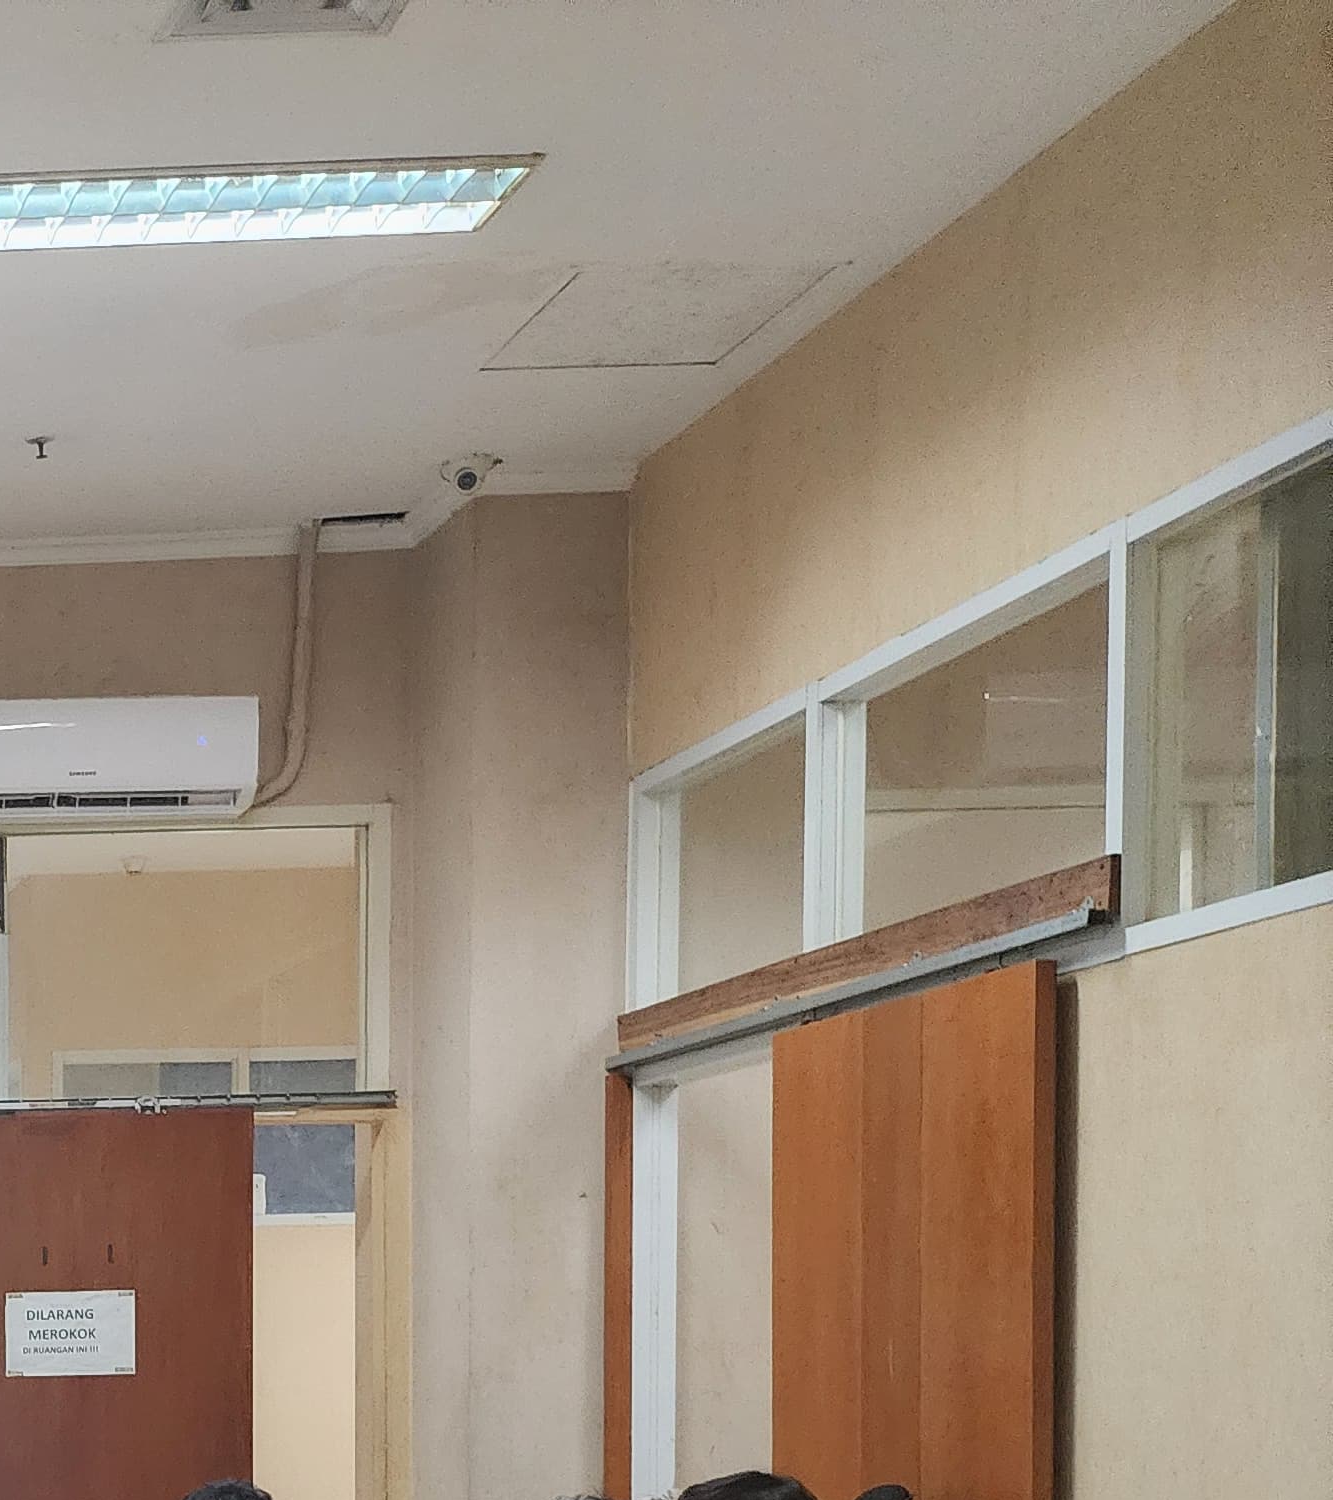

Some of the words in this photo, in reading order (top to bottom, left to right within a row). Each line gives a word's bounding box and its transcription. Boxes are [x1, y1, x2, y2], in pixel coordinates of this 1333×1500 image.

[26, 1308, 94, 1321] DILARANG
[28, 1327, 97, 1341] MEROKOK
[22, 1346, 31, 1354] DI
[33, 1345, 74, 1354] RUANGAN
[76, 1345, 88, 1353] INI
